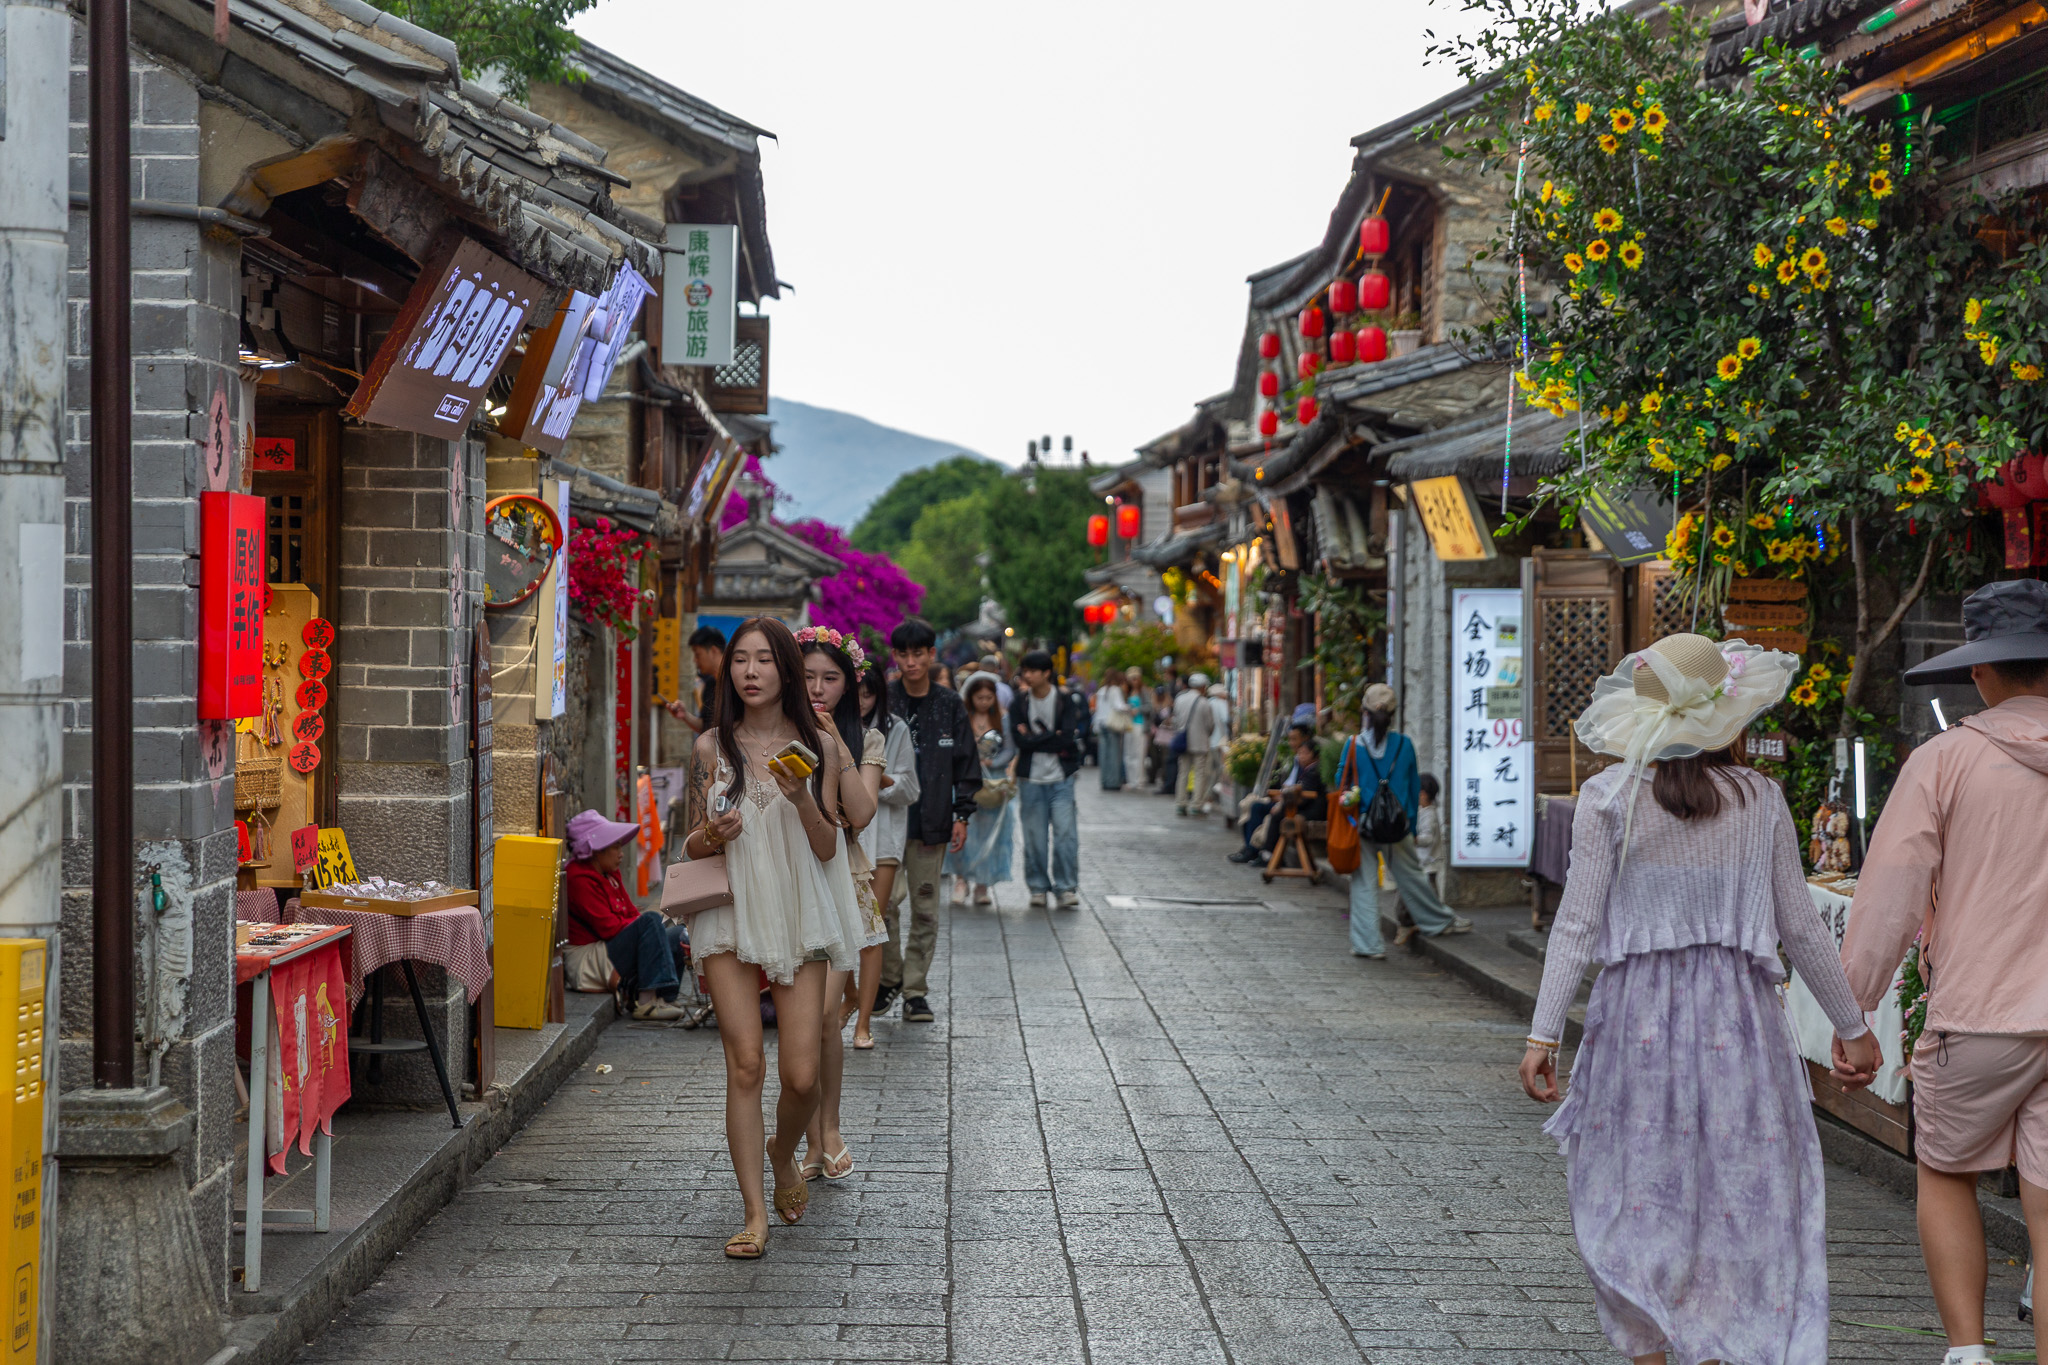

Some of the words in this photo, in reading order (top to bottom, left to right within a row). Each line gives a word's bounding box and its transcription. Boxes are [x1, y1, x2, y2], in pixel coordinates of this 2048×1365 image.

[234, 527, 260, 587] 原创
[233, 590, 260, 651] 手作
[1463, 609, 1492, 753] 全场耳环
[1465, 777, 1481, 847] 可换耳夹
